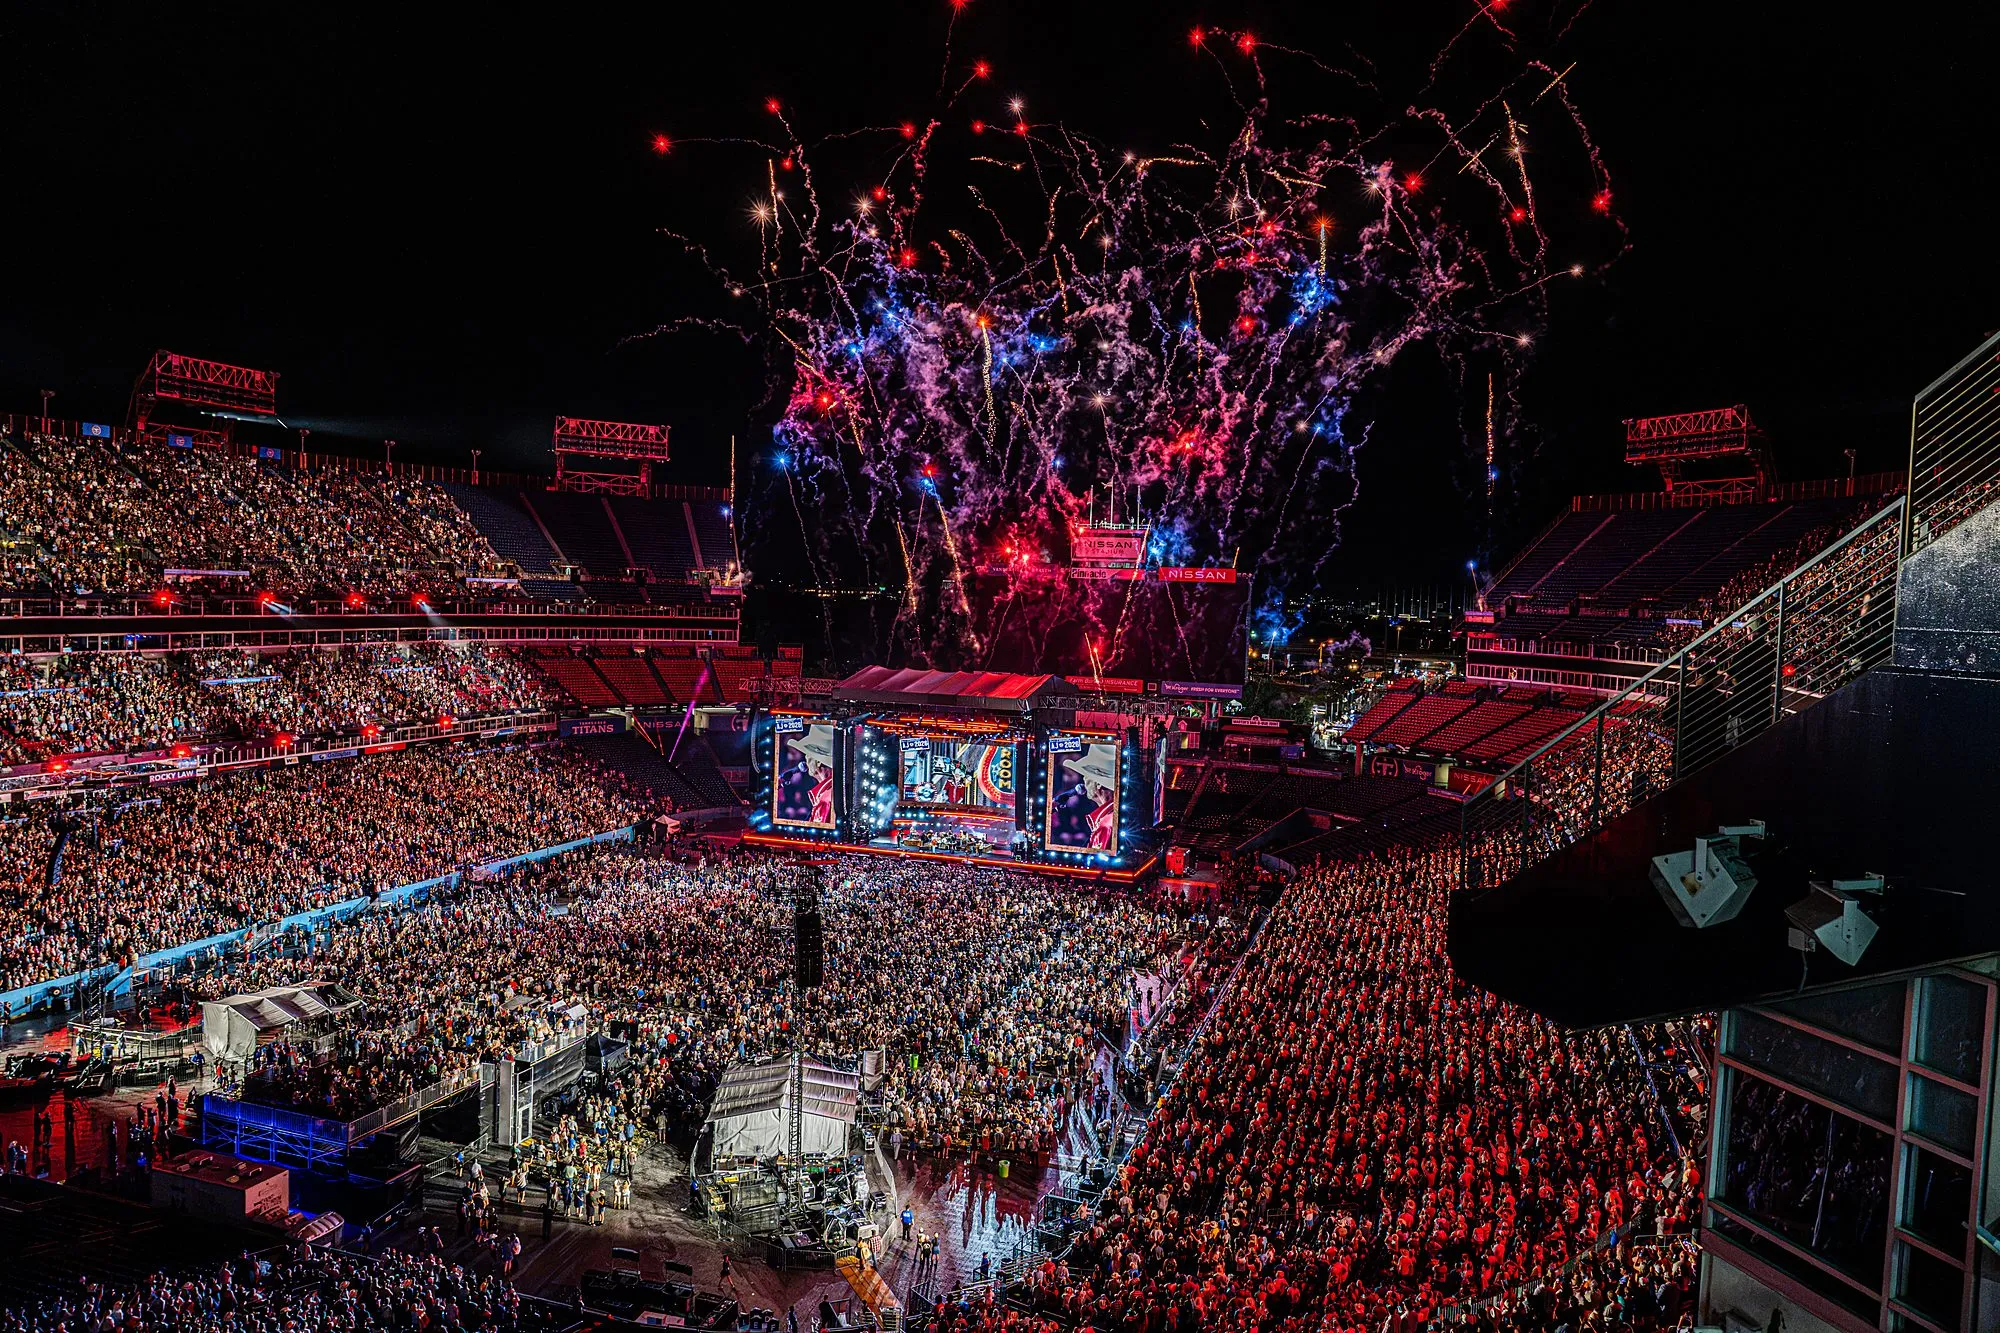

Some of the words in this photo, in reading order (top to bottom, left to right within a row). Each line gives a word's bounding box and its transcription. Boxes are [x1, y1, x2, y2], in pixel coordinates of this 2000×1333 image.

[1085, 541, 1133, 549] NISSAN
[1168, 570, 1227, 580] NISSAN
[572, 724, 614, 735] TITANS
[643, 720, 691, 729] NISSAN
[1000, 747, 1012, 790] ROOM
[149, 771, 176, 783] ROCKY
[177, 769, 194, 778] LAW
[1454, 772, 1489, 784] NISSAN
